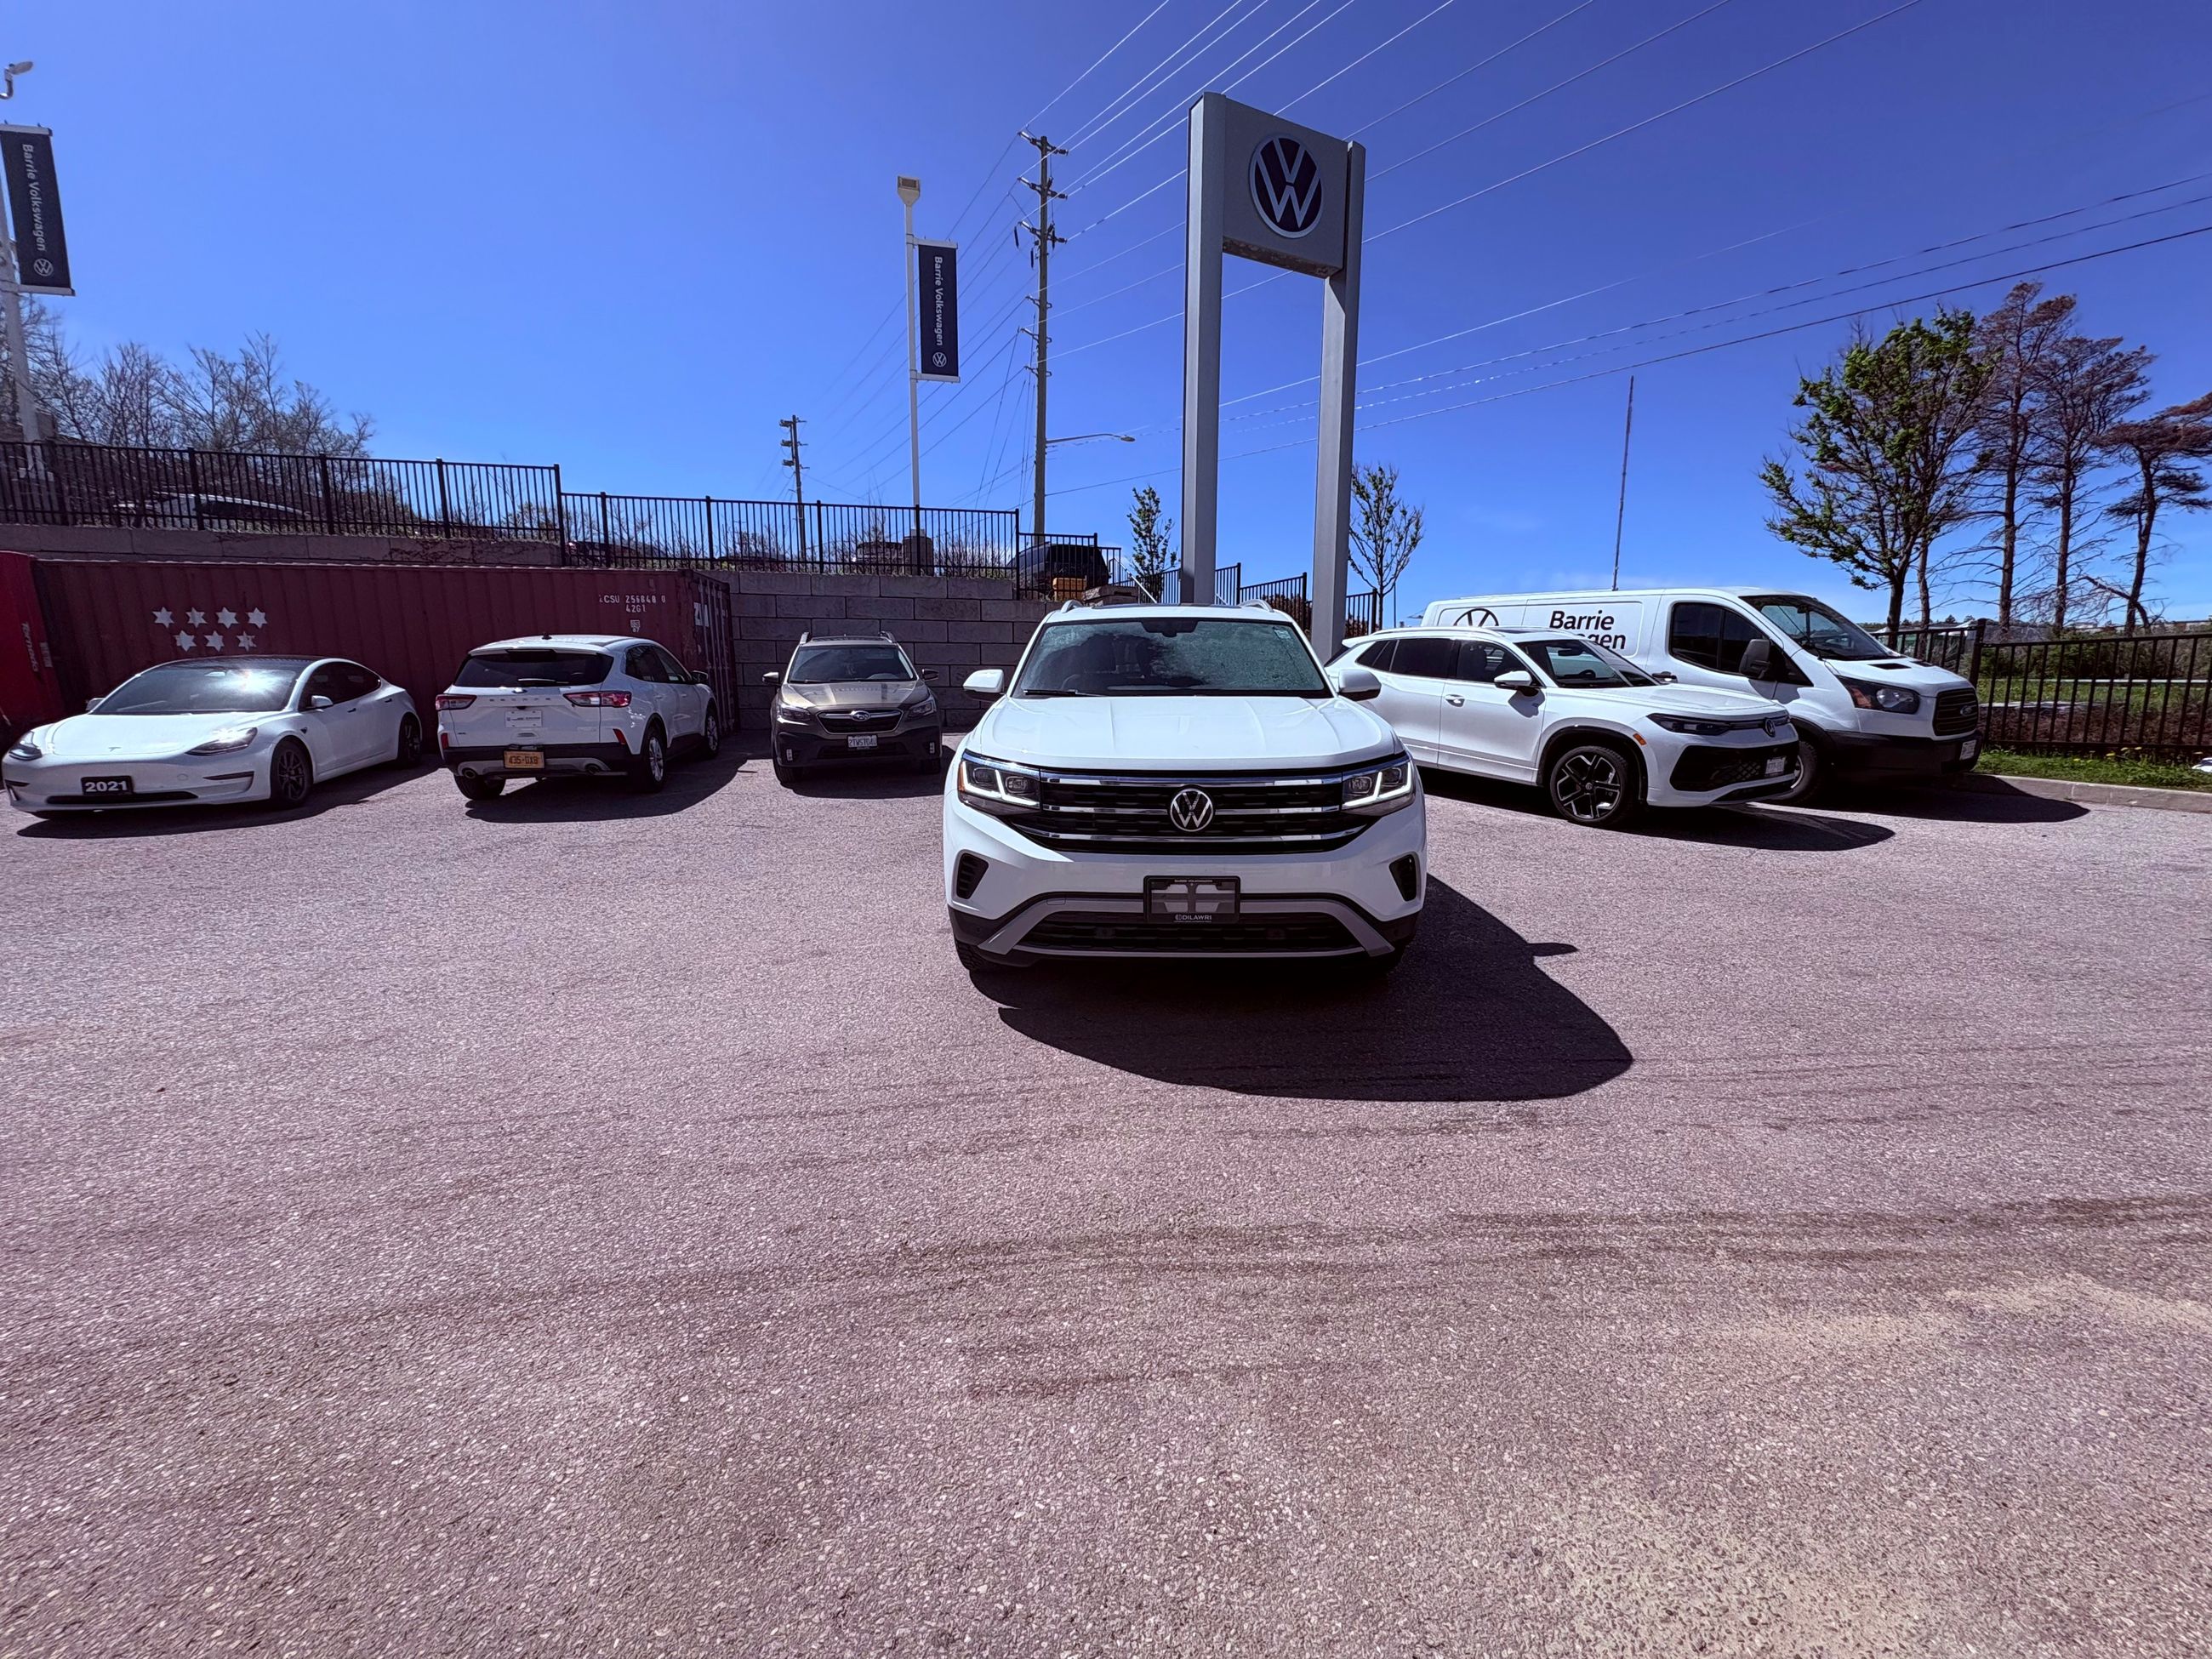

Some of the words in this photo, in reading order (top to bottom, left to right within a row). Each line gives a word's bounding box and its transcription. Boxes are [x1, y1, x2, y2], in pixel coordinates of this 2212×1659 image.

[22, 143, 36, 180] Barrie
[28, 181, 47, 252] Volkswagen
[934, 256, 944, 286] Barrie
[934, 288, 944, 346] Volkswagen
[1549, 609, 1615, 631] Barrie
[21, 621, 39, 672] Tornado
[85, 780, 128, 792] 2021
